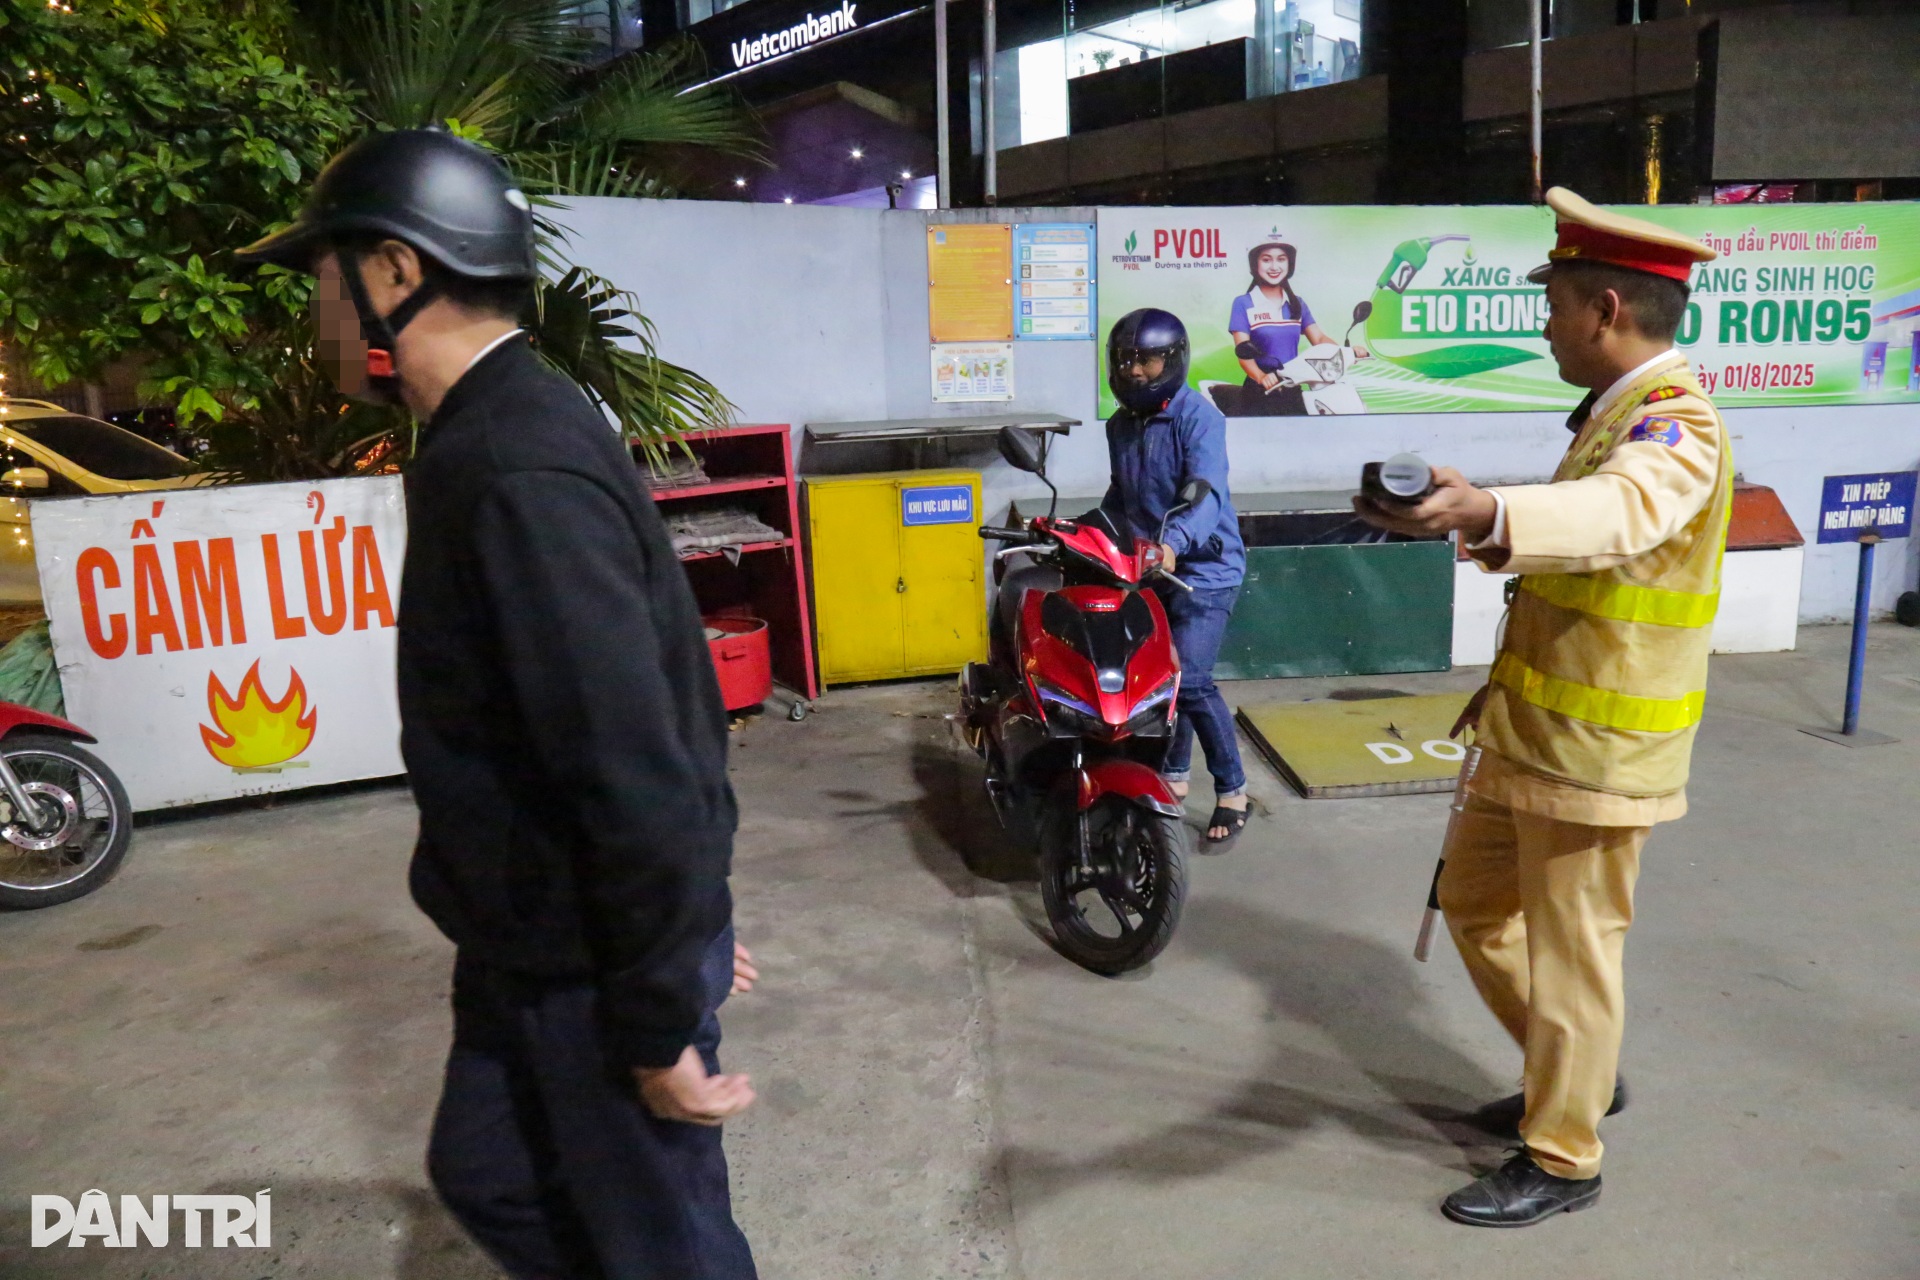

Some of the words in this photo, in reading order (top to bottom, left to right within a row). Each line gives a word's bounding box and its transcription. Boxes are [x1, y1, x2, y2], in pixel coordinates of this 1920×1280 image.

[732, 0, 857, 68] Vietcombank
[1154, 228, 1227, 259] PVOIL
[1697, 232, 1731, 257] ăng
[1737, 226, 1764, 252] dầu
[1769, 232, 1811, 251] PVOIL
[1815, 229, 1836, 251] thí
[1840, 225, 1877, 250] điểm
[1441, 258, 1511, 287] XĂNG
[1756, 266, 1815, 292] SINH
[1824, 265, 1875, 297] HỌC
[1401, 294, 1458, 333] E10
[1465, 293, 1552, 333] RON9
[1718, 299, 1872, 345] RON95
[1694, 363, 1718, 395] ày
[1724, 362, 1815, 392] 01/8/2025
[1841, 483, 1862, 503] XIN
[1863, 478, 1892, 501] PHÉP
[908, 501, 922, 514] KHU
[923, 499, 937, 516] VỰC
[1824, 504, 1850, 530] NGHỈ
[1877, 503, 1906, 526] HÀNG
[76, 500, 248, 660] CẤM
[260, 490, 396, 641] LỬA
